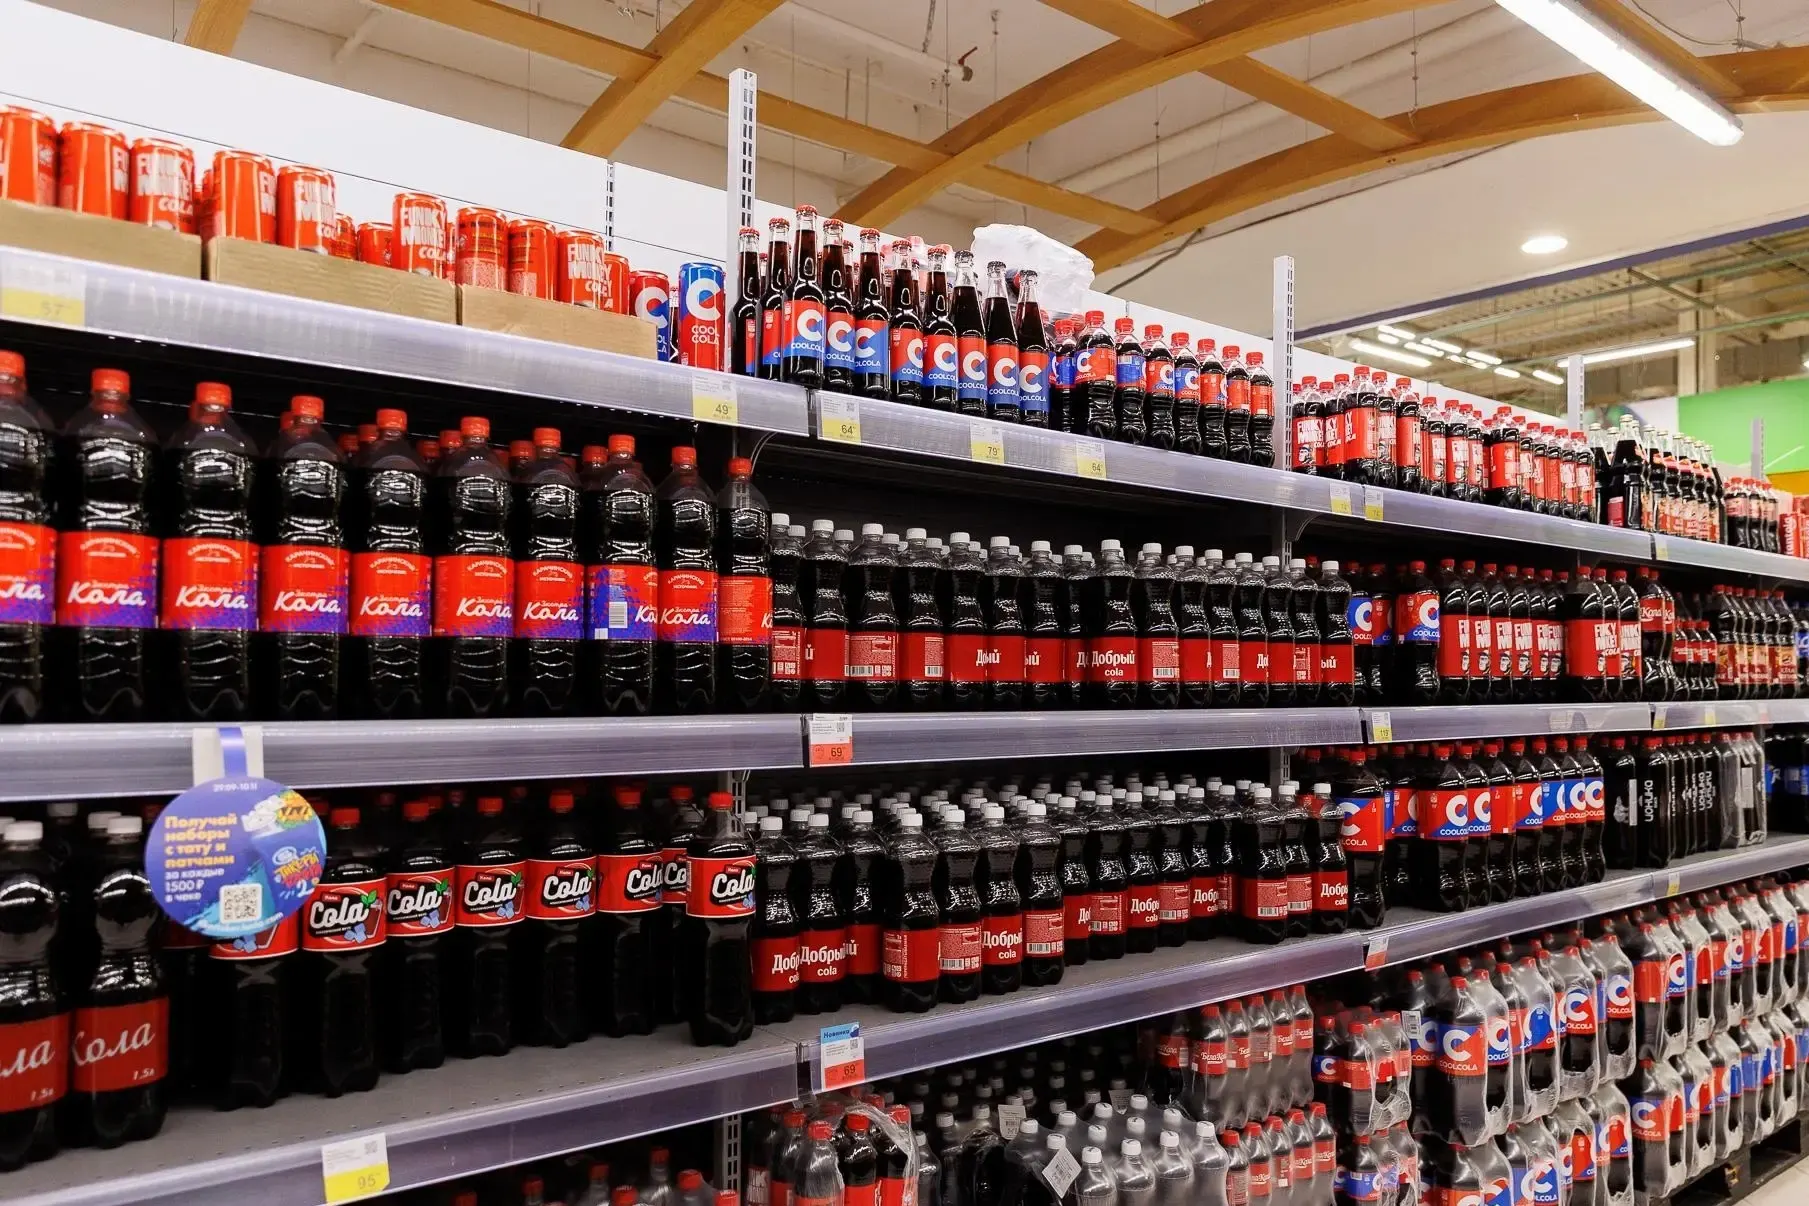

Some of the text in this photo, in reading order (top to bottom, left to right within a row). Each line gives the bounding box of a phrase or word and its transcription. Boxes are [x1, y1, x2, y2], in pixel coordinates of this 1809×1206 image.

[692, 325, 720, 336] COOL
[692, 335, 719, 345] COLA
[715, 403, 729, 415] 49
[68, 581, 147, 606] Кола
[176, 585, 249, 608] Кола
[274, 591, 341, 612] Кола
[360, 596, 423, 616] Кола
[456, 597, 512, 617] Кола
[523, 602, 579, 620] Кола
[660, 608, 711, 624] Кола
[1091, 650, 1135, 667] Добрый
[1104, 669, 1124, 677] cola
[831, 747, 842, 757] 69
[165, 813, 237, 831] Получай
[165, 828, 230, 842] наборы
[165, 843, 226, 856] с тату и
[165, 855, 235, 868] патчами
[165, 868, 224, 880] за каждые
[626, 864, 663, 893] Cola
[165, 880, 195, 893] 1500
[464, 877, 517, 906] Cola
[543, 872, 592, 900] Cola
[712, 869, 755, 898] Cola
[387, 885, 442, 915] Cola
[310, 897, 369, 929] Cola
[772, 951, 800, 974] Добр
[999, 949, 1016, 960] cola
[817, 966, 838, 977] cola
[823, 1029, 850, 1039] Новинка
[844, 1064, 855, 1075] 69
